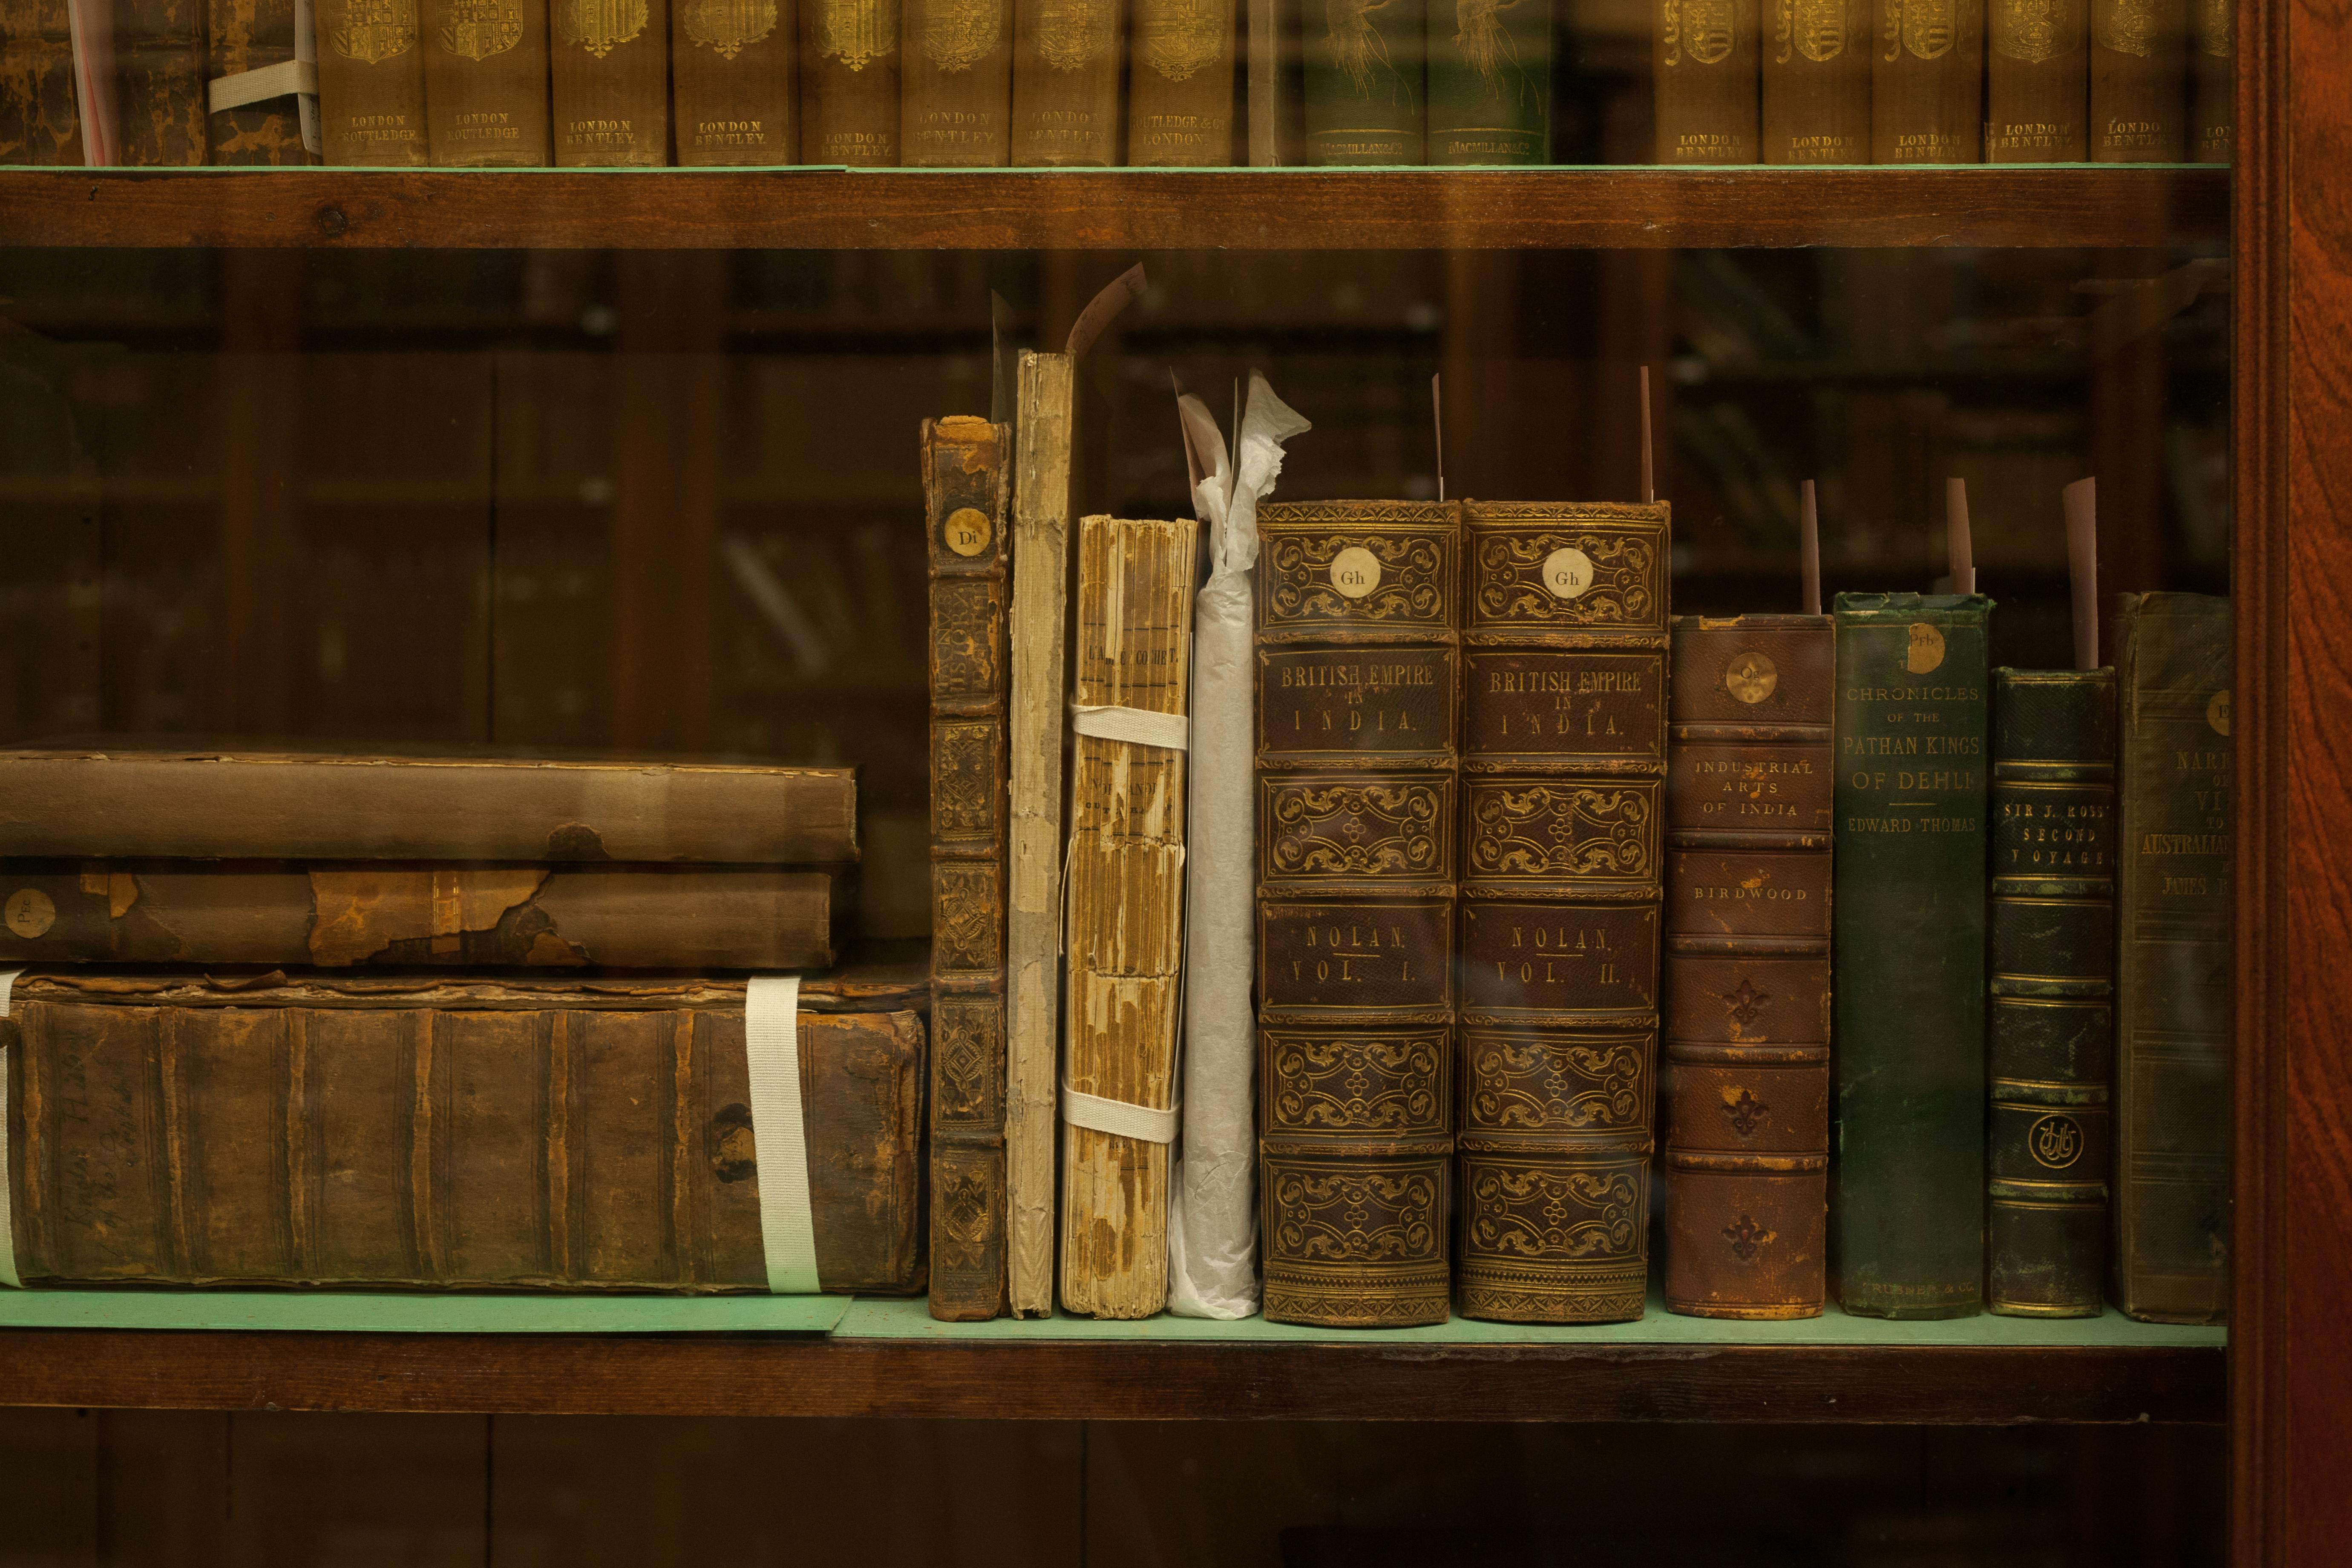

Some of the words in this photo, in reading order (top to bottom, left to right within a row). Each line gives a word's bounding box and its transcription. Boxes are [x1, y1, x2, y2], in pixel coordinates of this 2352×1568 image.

[351, 115, 405, 127] LONDON
[456, 113, 508, 125] LONDON
[920, 112, 989, 124] LONDON
[570, 121, 631, 132] LONDON
[700, 121, 761, 133] LONDON
[2108, 122, 2162, 134] LONDO
[343, 129, 416, 142] ROUTLEDGE
[567, 132, 636, 145] BENTLEY.
[695, 133, 766, 145] BENTLEY.
[826, 133, 887, 145] LONDON
[1681, 134, 1740, 146] LONDON
[1792, 136, 1854, 148] LONDON
[958, 531, 978, 545] Di
[1341, 571, 1365, 586] Gh
[1555, 571, 1580, 586] Gh
[1281, 665, 1359, 687] BRITISH
[1370, 664, 1434, 685] EMPIRE
[1740, 667, 1760, 681] Og
[1490, 671, 1571, 692] BRITISH
[1580, 671, 1641, 691] EMPIRE
[1347, 691, 1363, 704] IN
[1846, 687, 1979, 701] CHRONICLES
[1555, 696, 1572, 709] IN
[1295, 710, 1417, 731] INDIA.
[1501, 714, 1624, 735] INDIA.
[1887, 713, 1903, 723] OF
[1914, 713, 1940, 722] THE
[1843, 737, 1917, 755] PATHAN
[1926, 737, 1979, 755] KINGS
[1695, 761, 1814, 774] INDUSTRIAL
[1722, 781, 1778, 794] ARTS
[1852, 771, 1886, 790] OF
[1898, 771, 1971, 790] DEHLI
[1703, 802, 1727, 814] OF
[1740, 803, 1797, 816] INDIA
[2004, 803, 2033, 817] SIR
[2044, 805, 2057, 818] J.
[1848, 818, 1911, 832] EDWARD
[1920, 817, 1976, 832] THOMAS
[2024, 828, 2096, 842] SECOND
[2011, 849, 2102, 865] VOYAGE
[2162, 877, 2207, 895] JAMES
[1694, 887, 1807, 901] BIRDWOOD
[1307, 926, 1405, 948] NOLAN.
[1511, 926, 1612, 951] NOLAN.
[1292, 960, 1362, 982] VOL.
[1497, 961, 1565, 983] VOL.
[1600, 963, 1620, 984] II.
[1945, 1284, 1954, 1294] &
